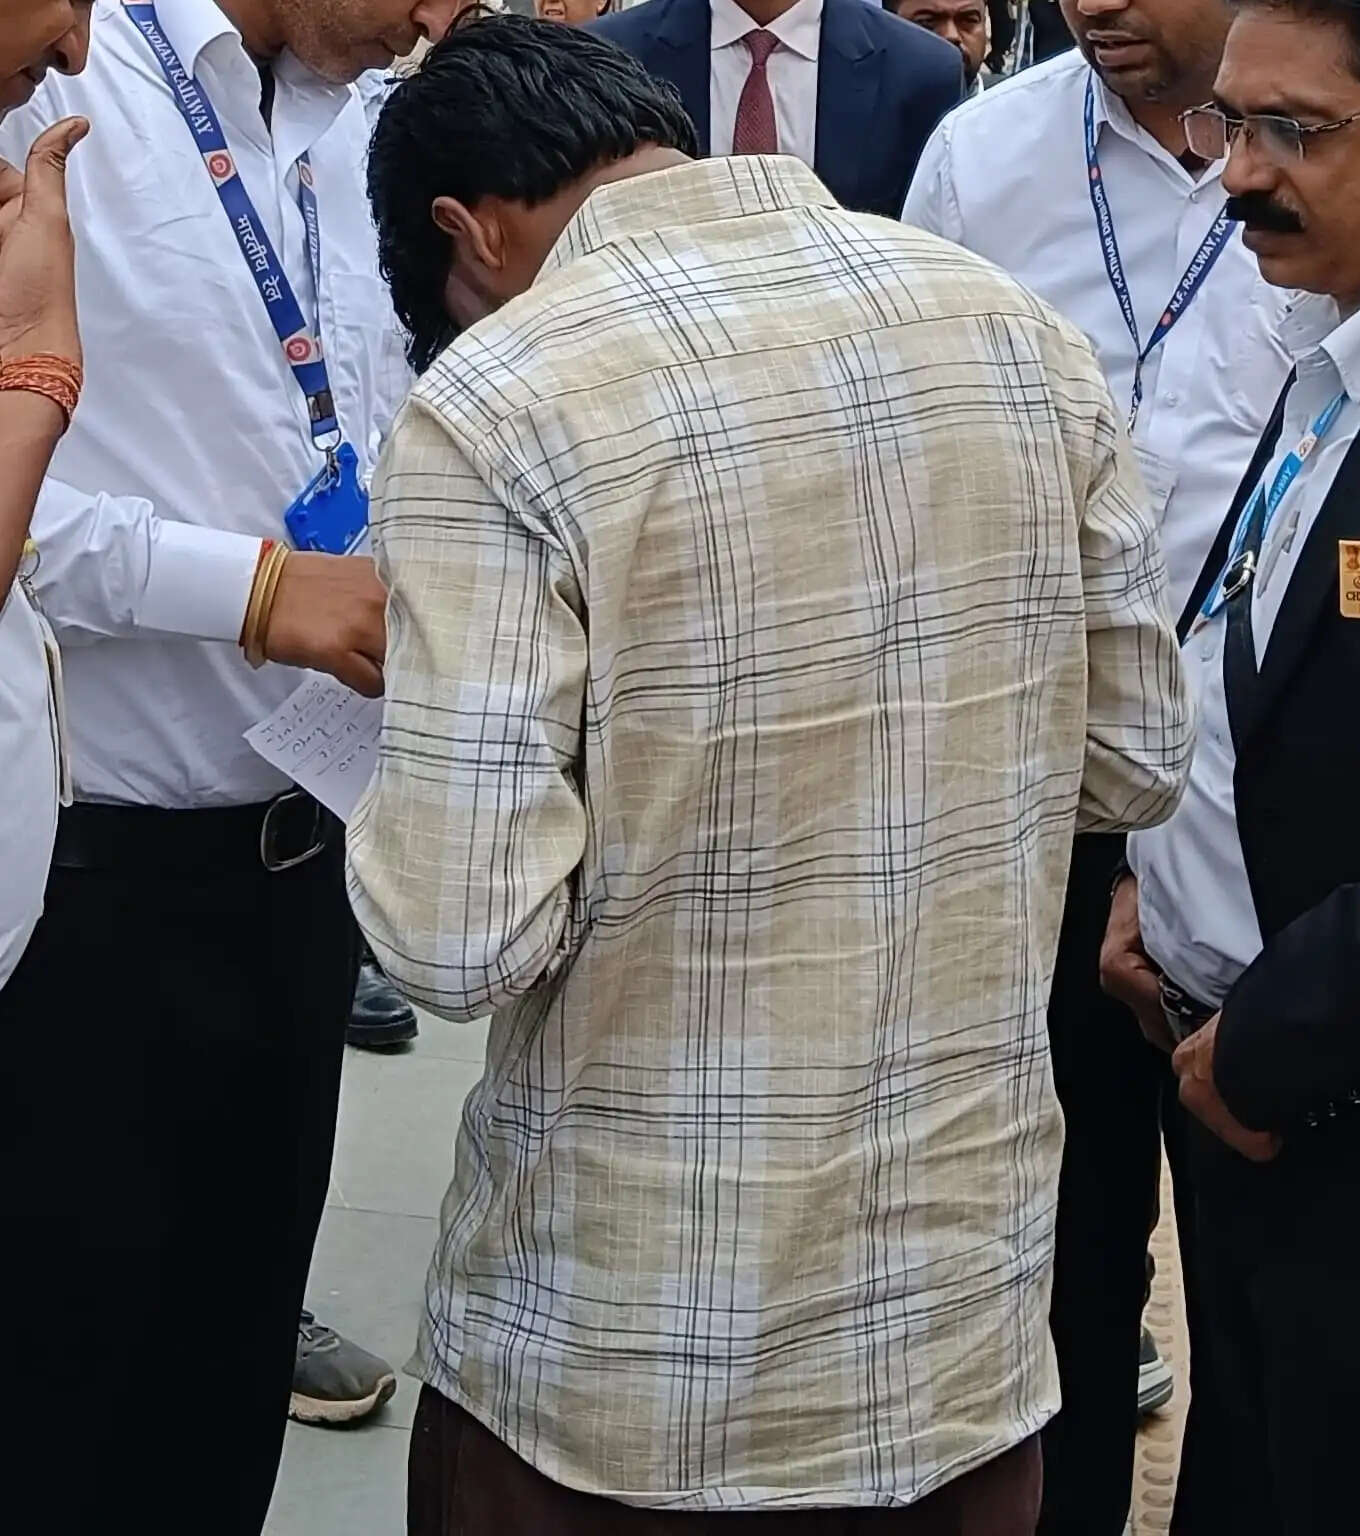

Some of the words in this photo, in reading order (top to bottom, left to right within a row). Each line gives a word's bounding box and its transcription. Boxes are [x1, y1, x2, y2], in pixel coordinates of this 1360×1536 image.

[139, 20, 179, 67] INDIAN
[168, 64, 215, 136] RAILWAY
[236, 214, 270, 274] भारतीय
[261, 274, 283, 303] रेल
